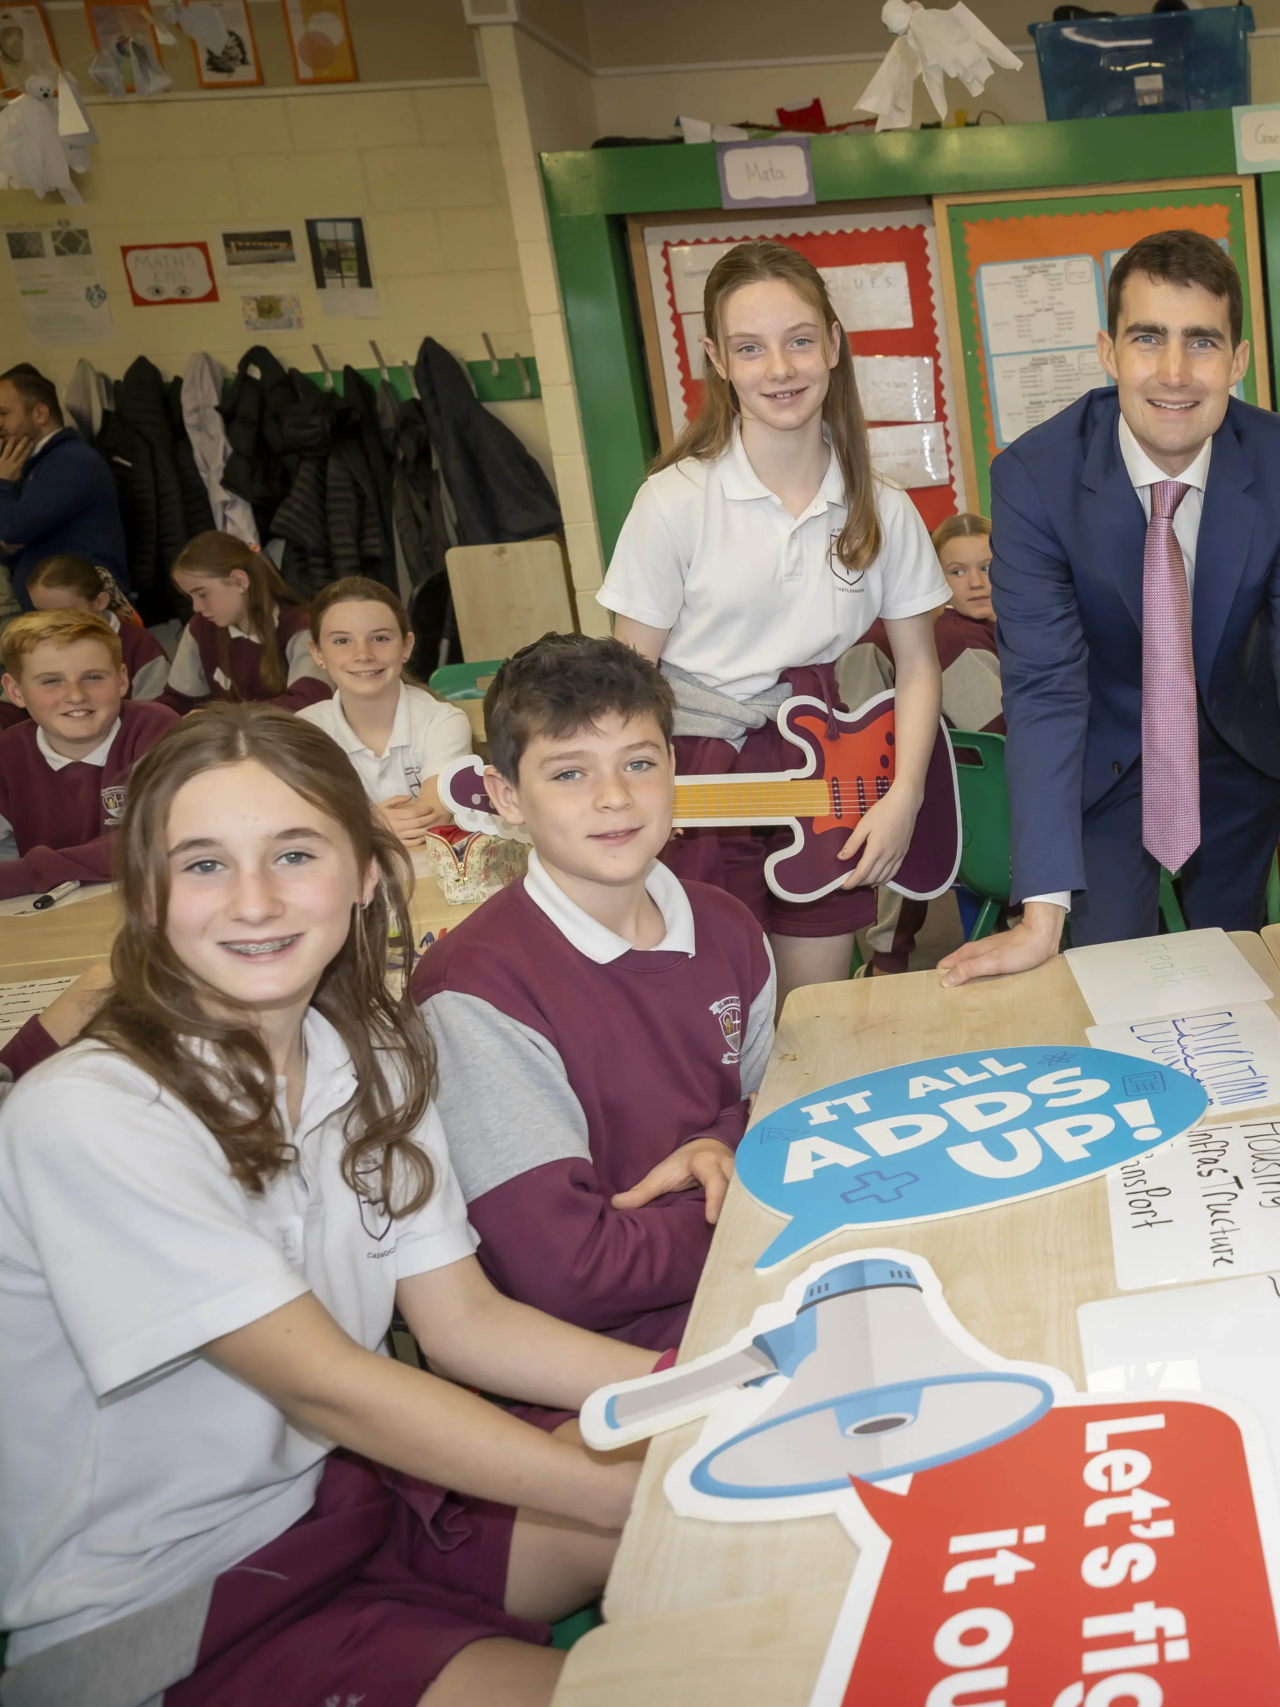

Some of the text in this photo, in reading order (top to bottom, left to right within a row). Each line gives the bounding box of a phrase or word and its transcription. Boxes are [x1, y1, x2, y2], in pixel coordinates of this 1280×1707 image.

[783, 1067, 1111, 1184] ADDS
[801, 1058, 1027, 1126] IT ALL
[946, 1099, 1163, 1179] UP!
[943, 1525, 1046, 1593] it
